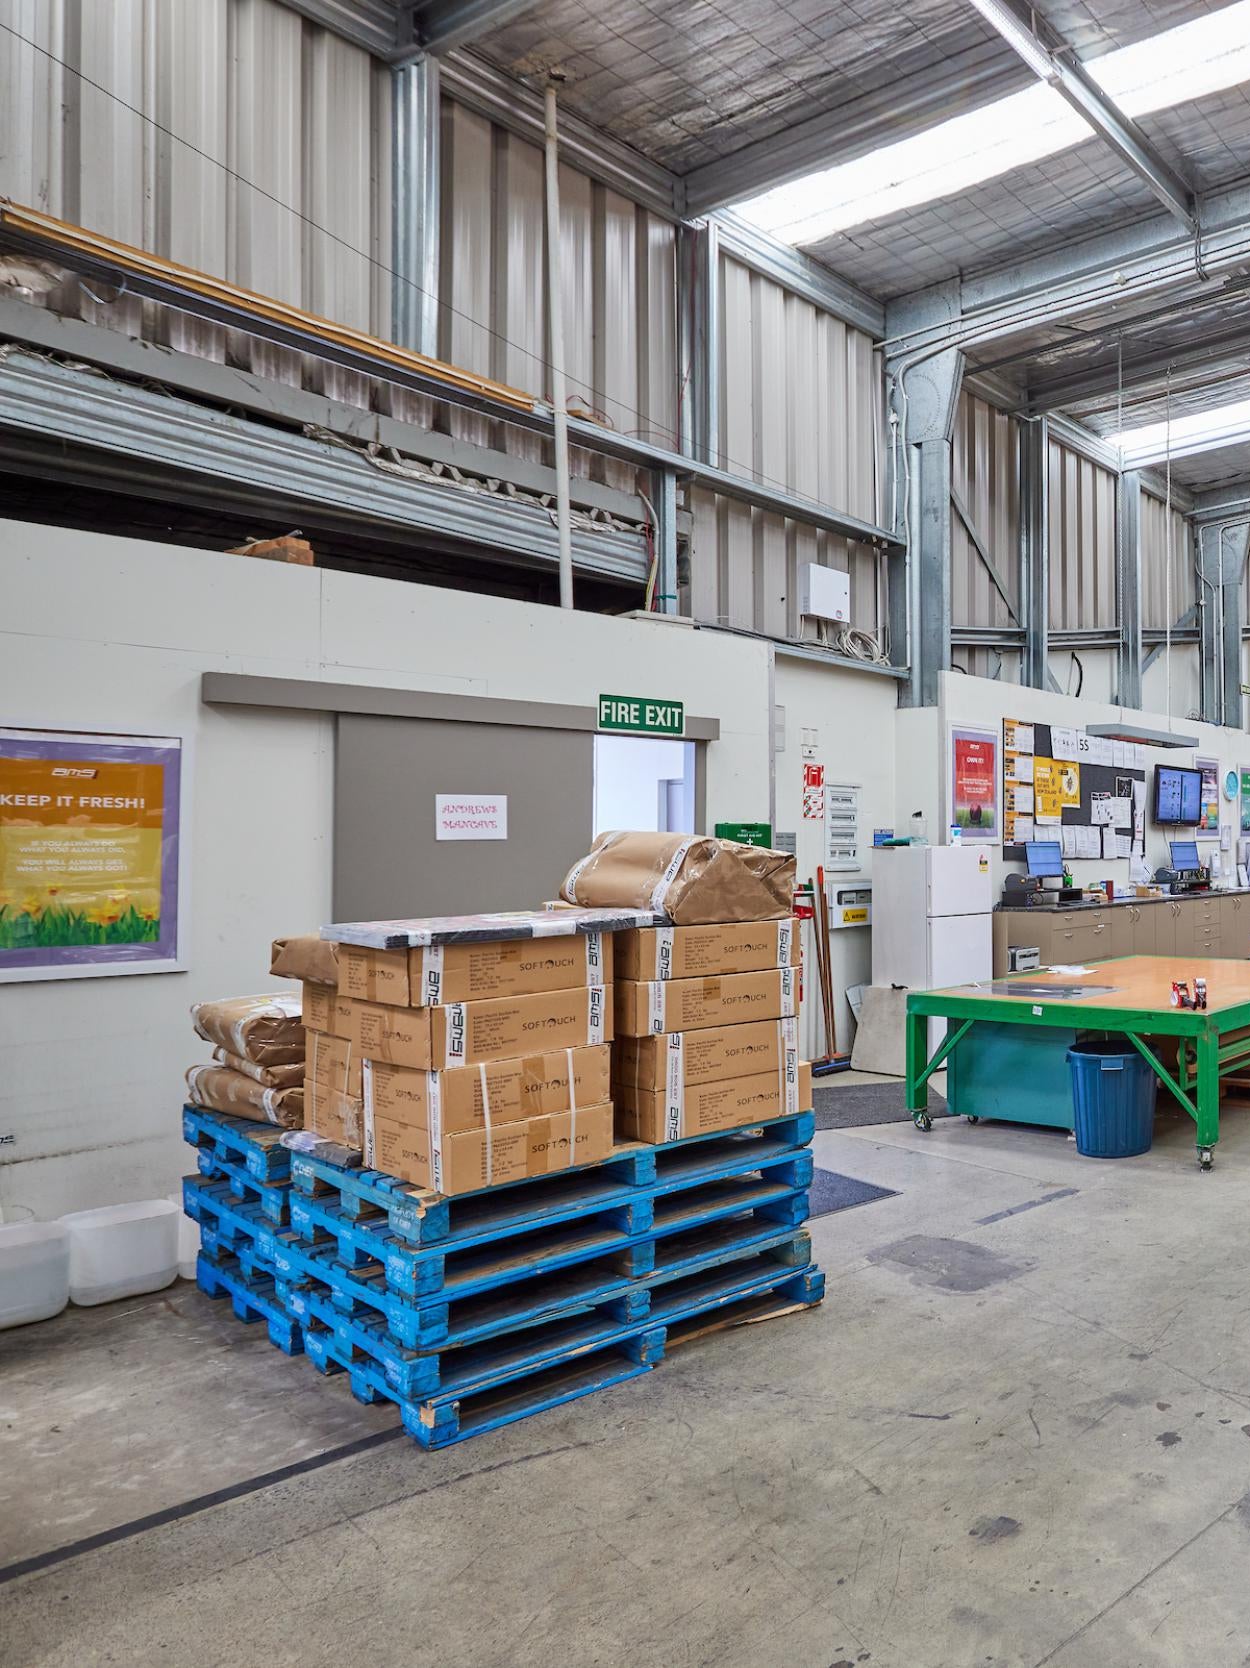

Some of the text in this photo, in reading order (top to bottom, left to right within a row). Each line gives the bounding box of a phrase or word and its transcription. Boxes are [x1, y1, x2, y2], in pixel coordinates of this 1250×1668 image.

[601, 700, 682, 728] FIRE EXIT
[1079, 739, 1089, 751] 5S
[1, 794, 145, 809] KEEP IT FRESH!
